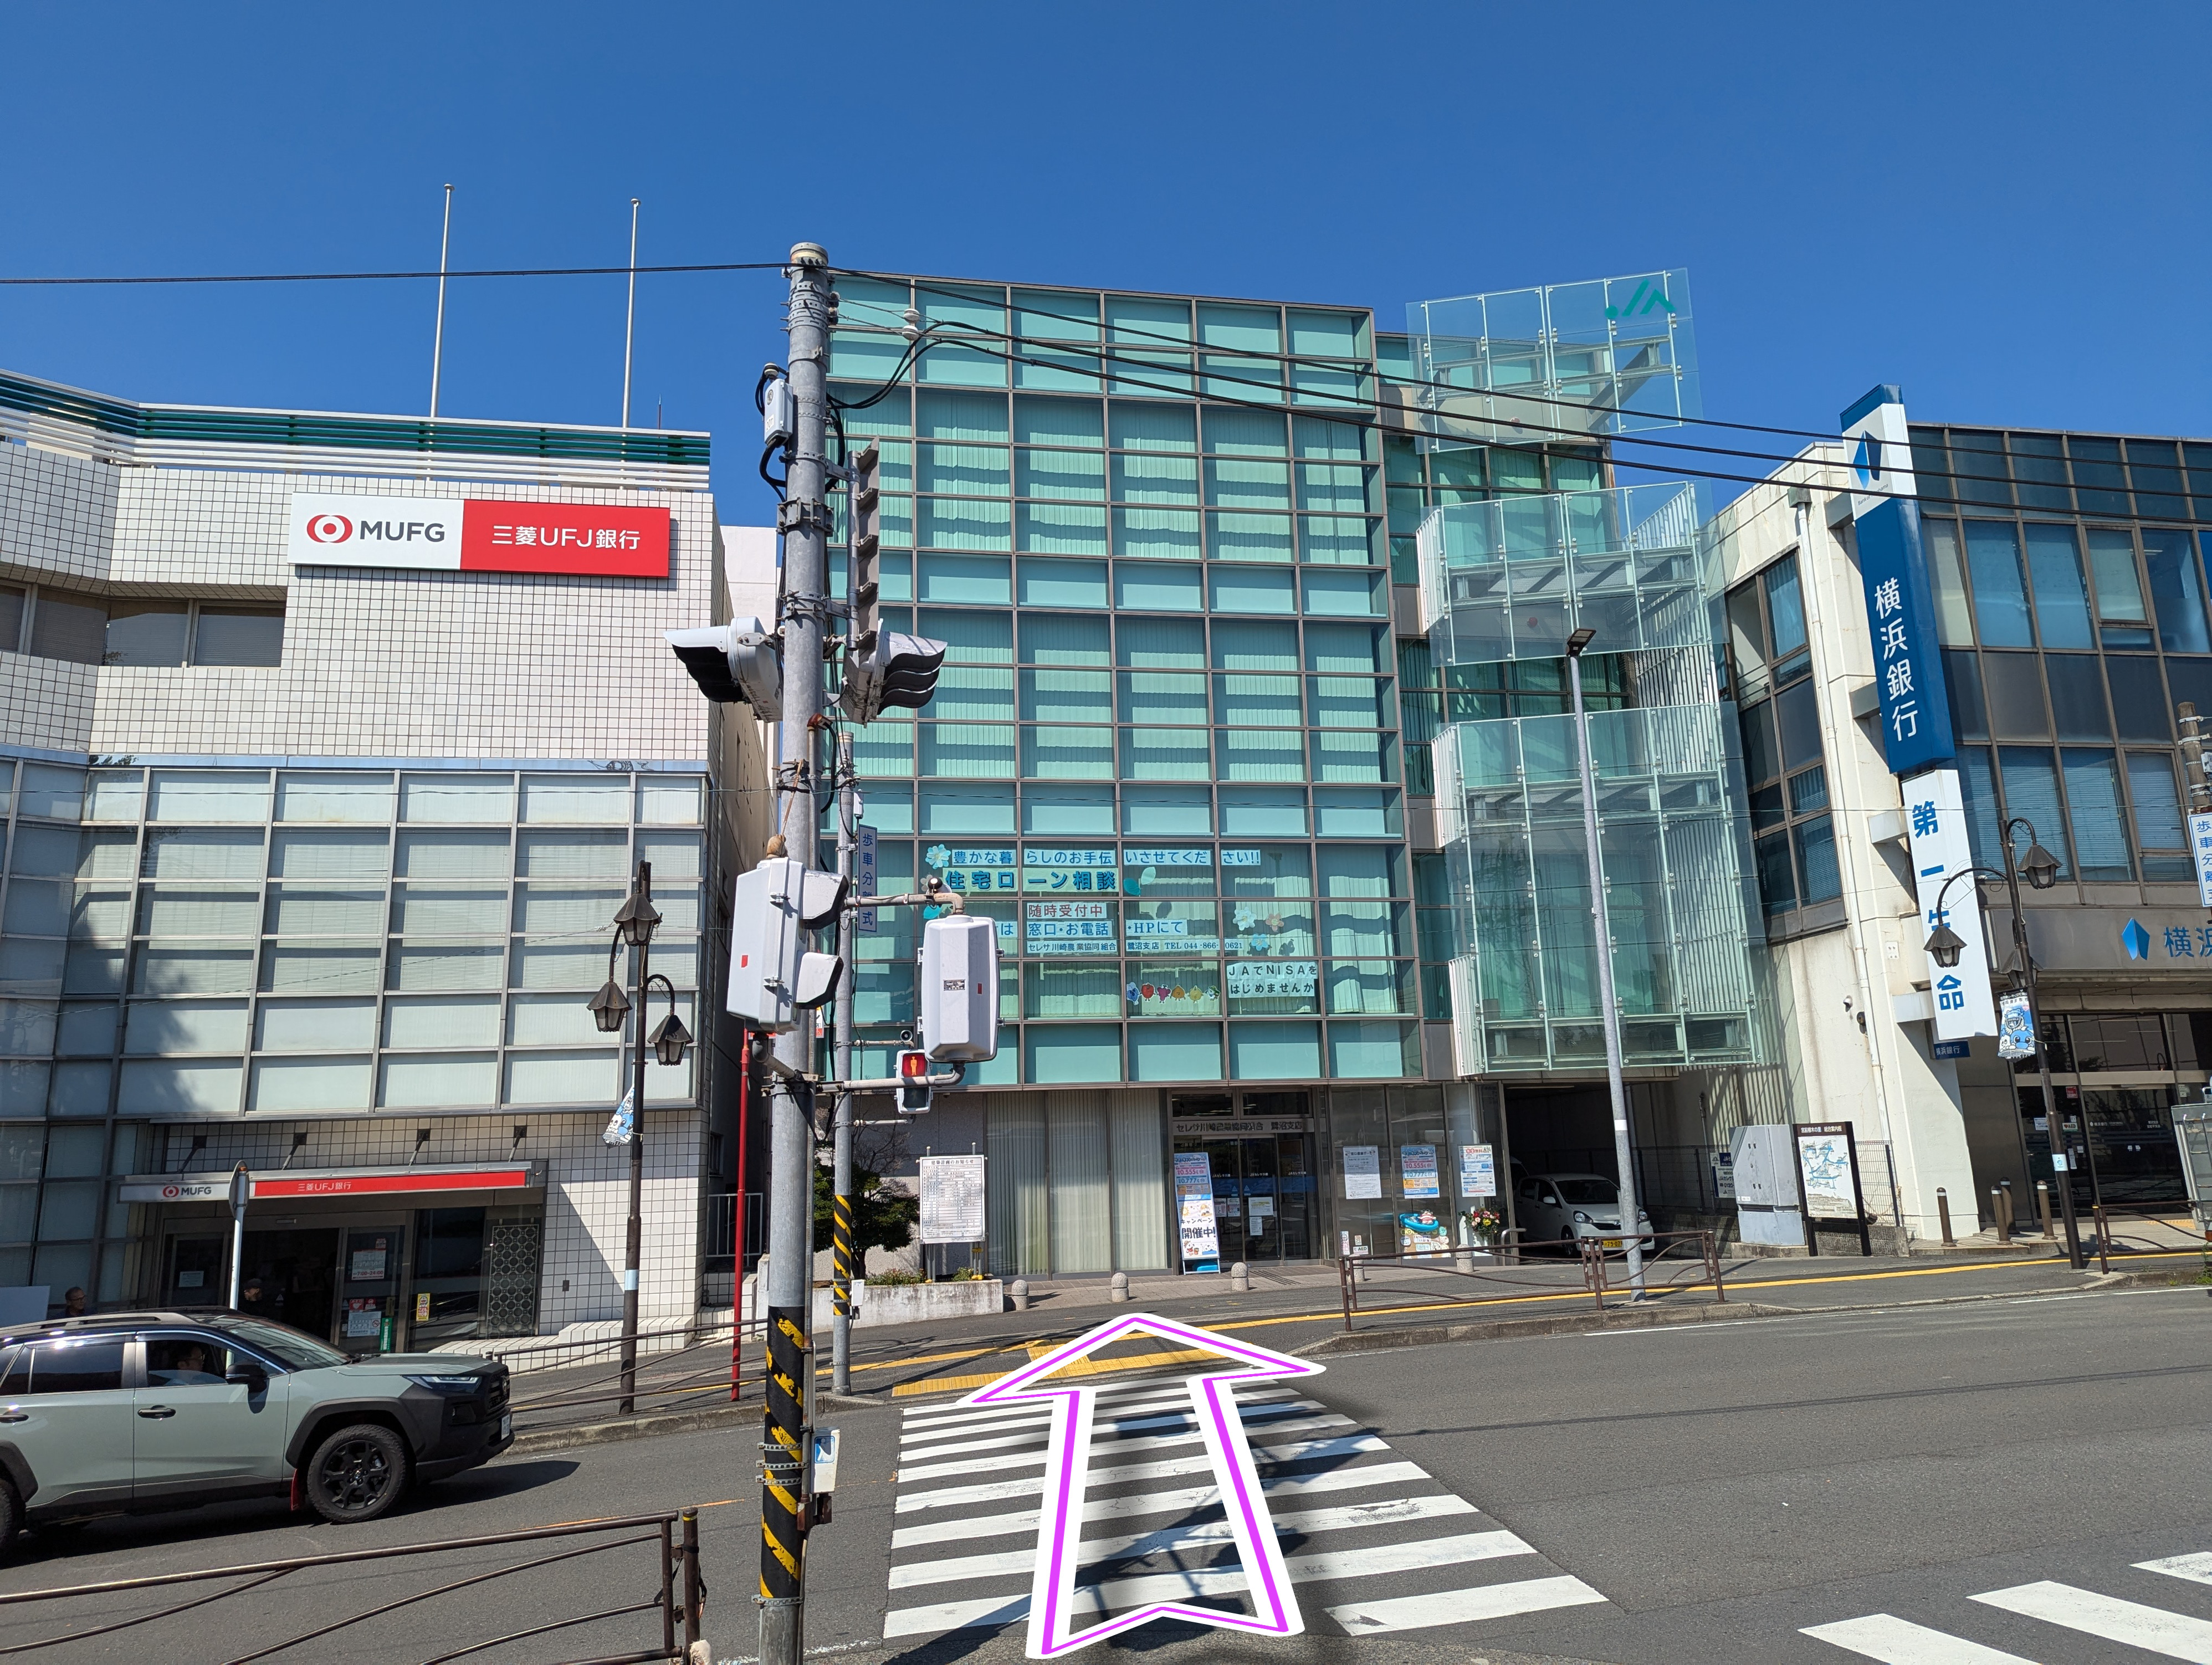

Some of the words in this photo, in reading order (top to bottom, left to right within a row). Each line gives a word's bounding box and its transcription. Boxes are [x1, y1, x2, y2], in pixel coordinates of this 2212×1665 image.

[360, 520, 445, 543] MUFG
[491, 525, 641, 550] 三菱UFJ銀行
[1874, 576, 1918, 742] 横浜銀行
[2196, 820, 2212, 899] 歩車分
[1028, 904, 1103, 918] 随時受付中
[1028, 942, 1117, 952] セレサ川崎農業協同組合
[1127, 942, 1159, 950] 鷺沼支店
[1230, 982, 1314, 993] はじめませんか
[1936, 1046, 1960, 1056] 横浜銀行
[181, 1186, 212, 1196] MUFG
[297, 1181, 351, 1191] 三菱UFJ銀行
